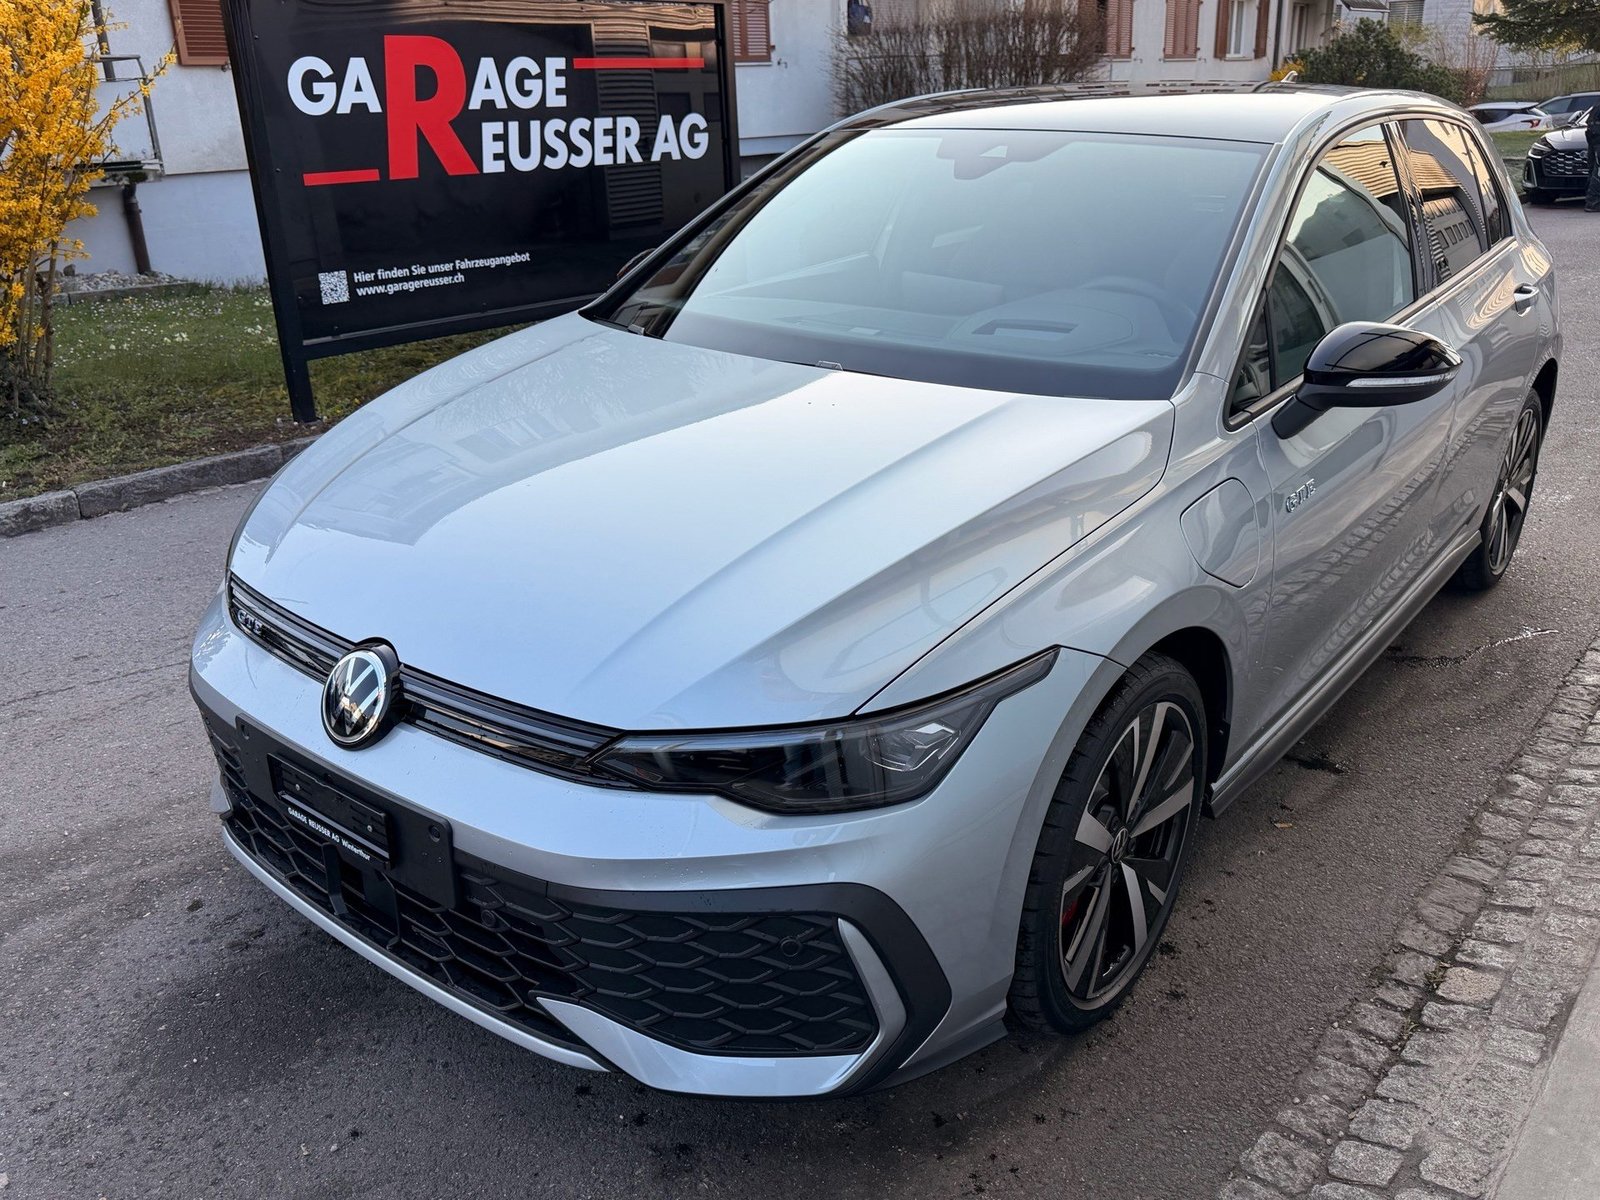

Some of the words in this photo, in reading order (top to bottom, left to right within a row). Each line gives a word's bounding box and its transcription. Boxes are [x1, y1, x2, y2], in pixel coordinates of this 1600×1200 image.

[287, 34, 567, 181] GARAGE
[650, 112, 709, 162] AG
[353, 271, 375, 283] Hier
[377, 266, 410, 280] finden
[411, 264, 426, 276] Sie
[427, 262, 454, 274] unser
[455, 252, 531, 270] Fahrzeugangebot
[356, 272, 465, 297] www.garagereusser.ch
[287, 806, 308, 824] GARAGE
[308, 818, 331, 838] REUSSER
[331, 832, 341, 843] AG
[341, 838, 371, 861] Winterthur
